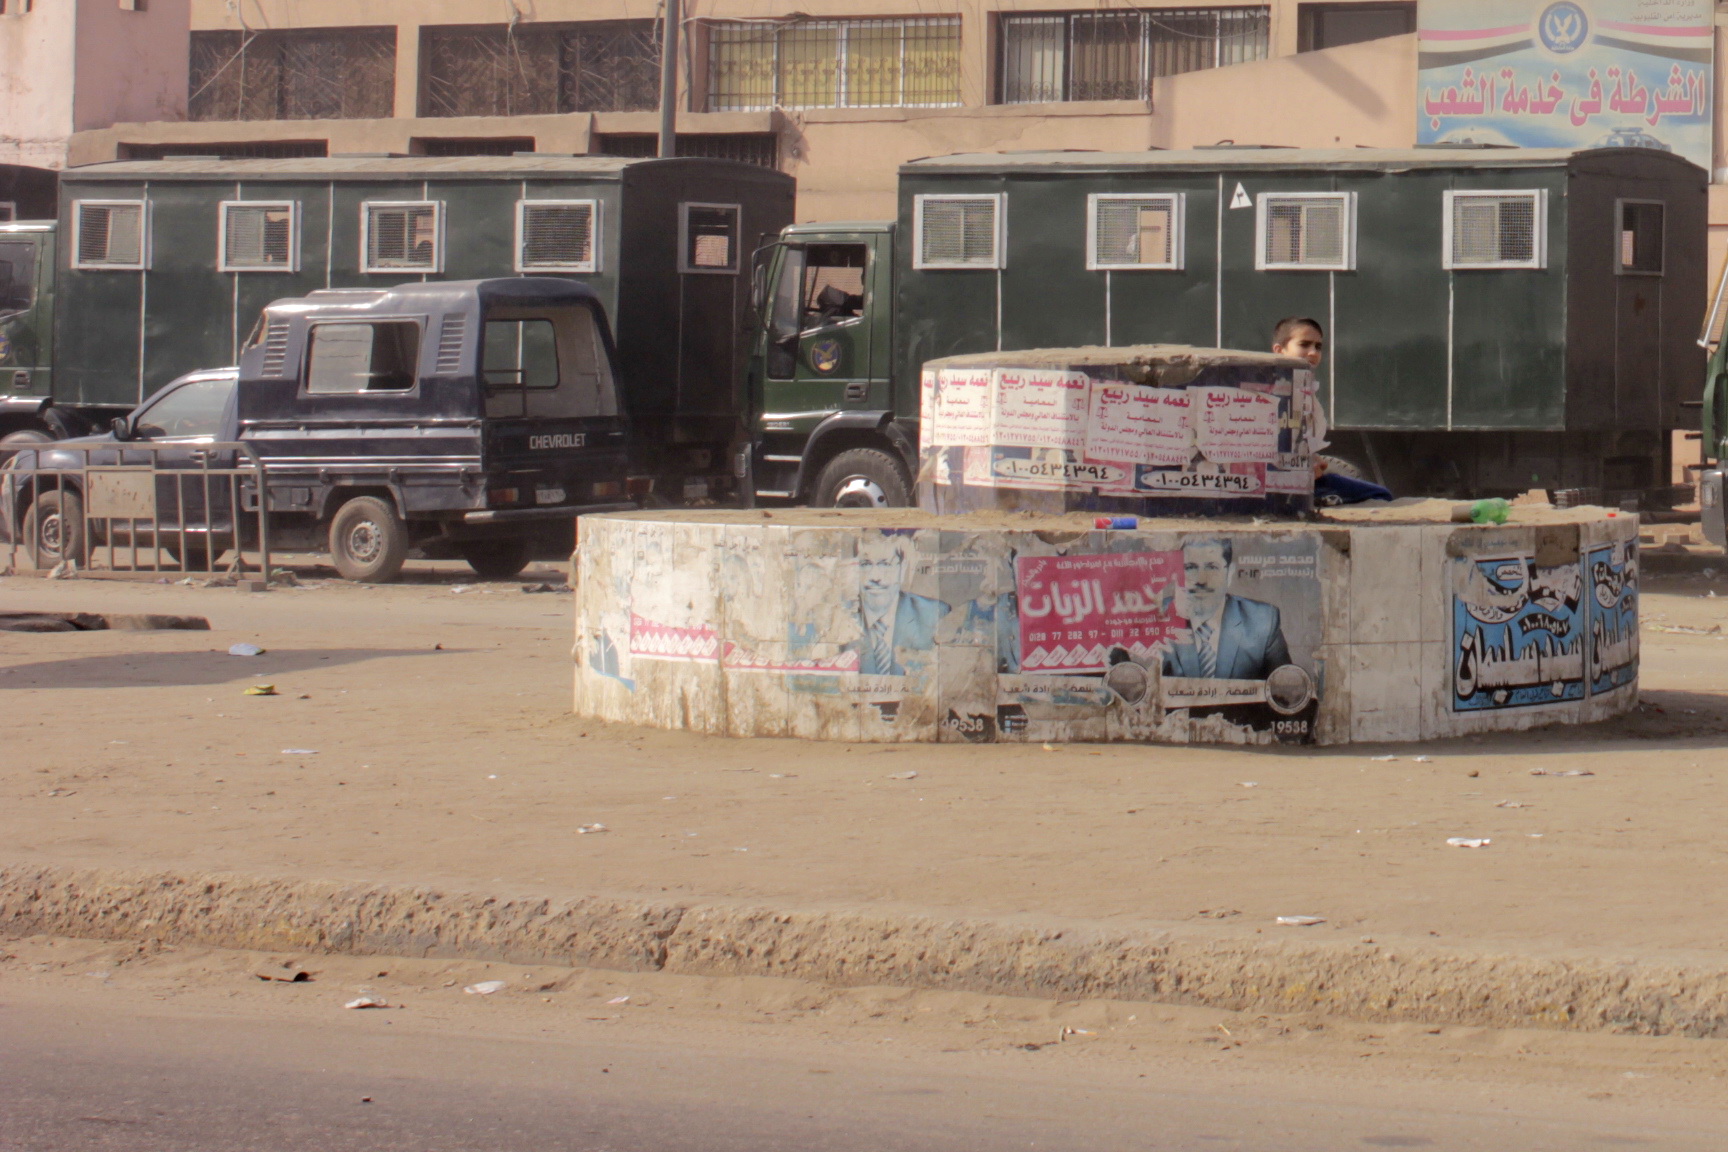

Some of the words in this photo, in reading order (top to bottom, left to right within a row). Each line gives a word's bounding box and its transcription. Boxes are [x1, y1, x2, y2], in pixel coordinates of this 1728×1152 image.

[1425, 66, 1496, 131] الشعب
[1501, 67, 1564, 115] خدمة
[1607, 63, 1705, 126] الشرطة
[950, 374, 967, 390] سيد
[1000, 373, 1026, 390] ربيع
[1029, 373, 1053, 391] سيد
[1056, 372, 1085, 390] نعمه
[1101, 388, 1130, 405] ربيع
[1133, 391, 1160, 408] سيد
[1163, 393, 1191, 408] نعمه
[1206, 392, 1230, 409] ربيع
[1233, 392, 1252, 408] سيد
[529, 433, 587, 450] CHEVROLET
[1006, 461, 1109, 480] ٠١٠٠٥٤٣٤٣٩٤
[1155, 473, 1249, 490] ٠١٠٠٥٤٣٤٣٩٤
[1279, 555, 1314, 565] محمد
[917, 566, 931, 575] ٠١٢
[1237, 568, 1260, 578] ٢٠١٢
[1022, 579, 1106, 625] الزيات
[1029, 632, 1047, 642] 0128
[1052, 631, 1062, 641] 77
[1088, 630, 1098, 639] 97
[1168, 687, 1195, 698] شعب
[1270, 719, 1308, 735] 19538
